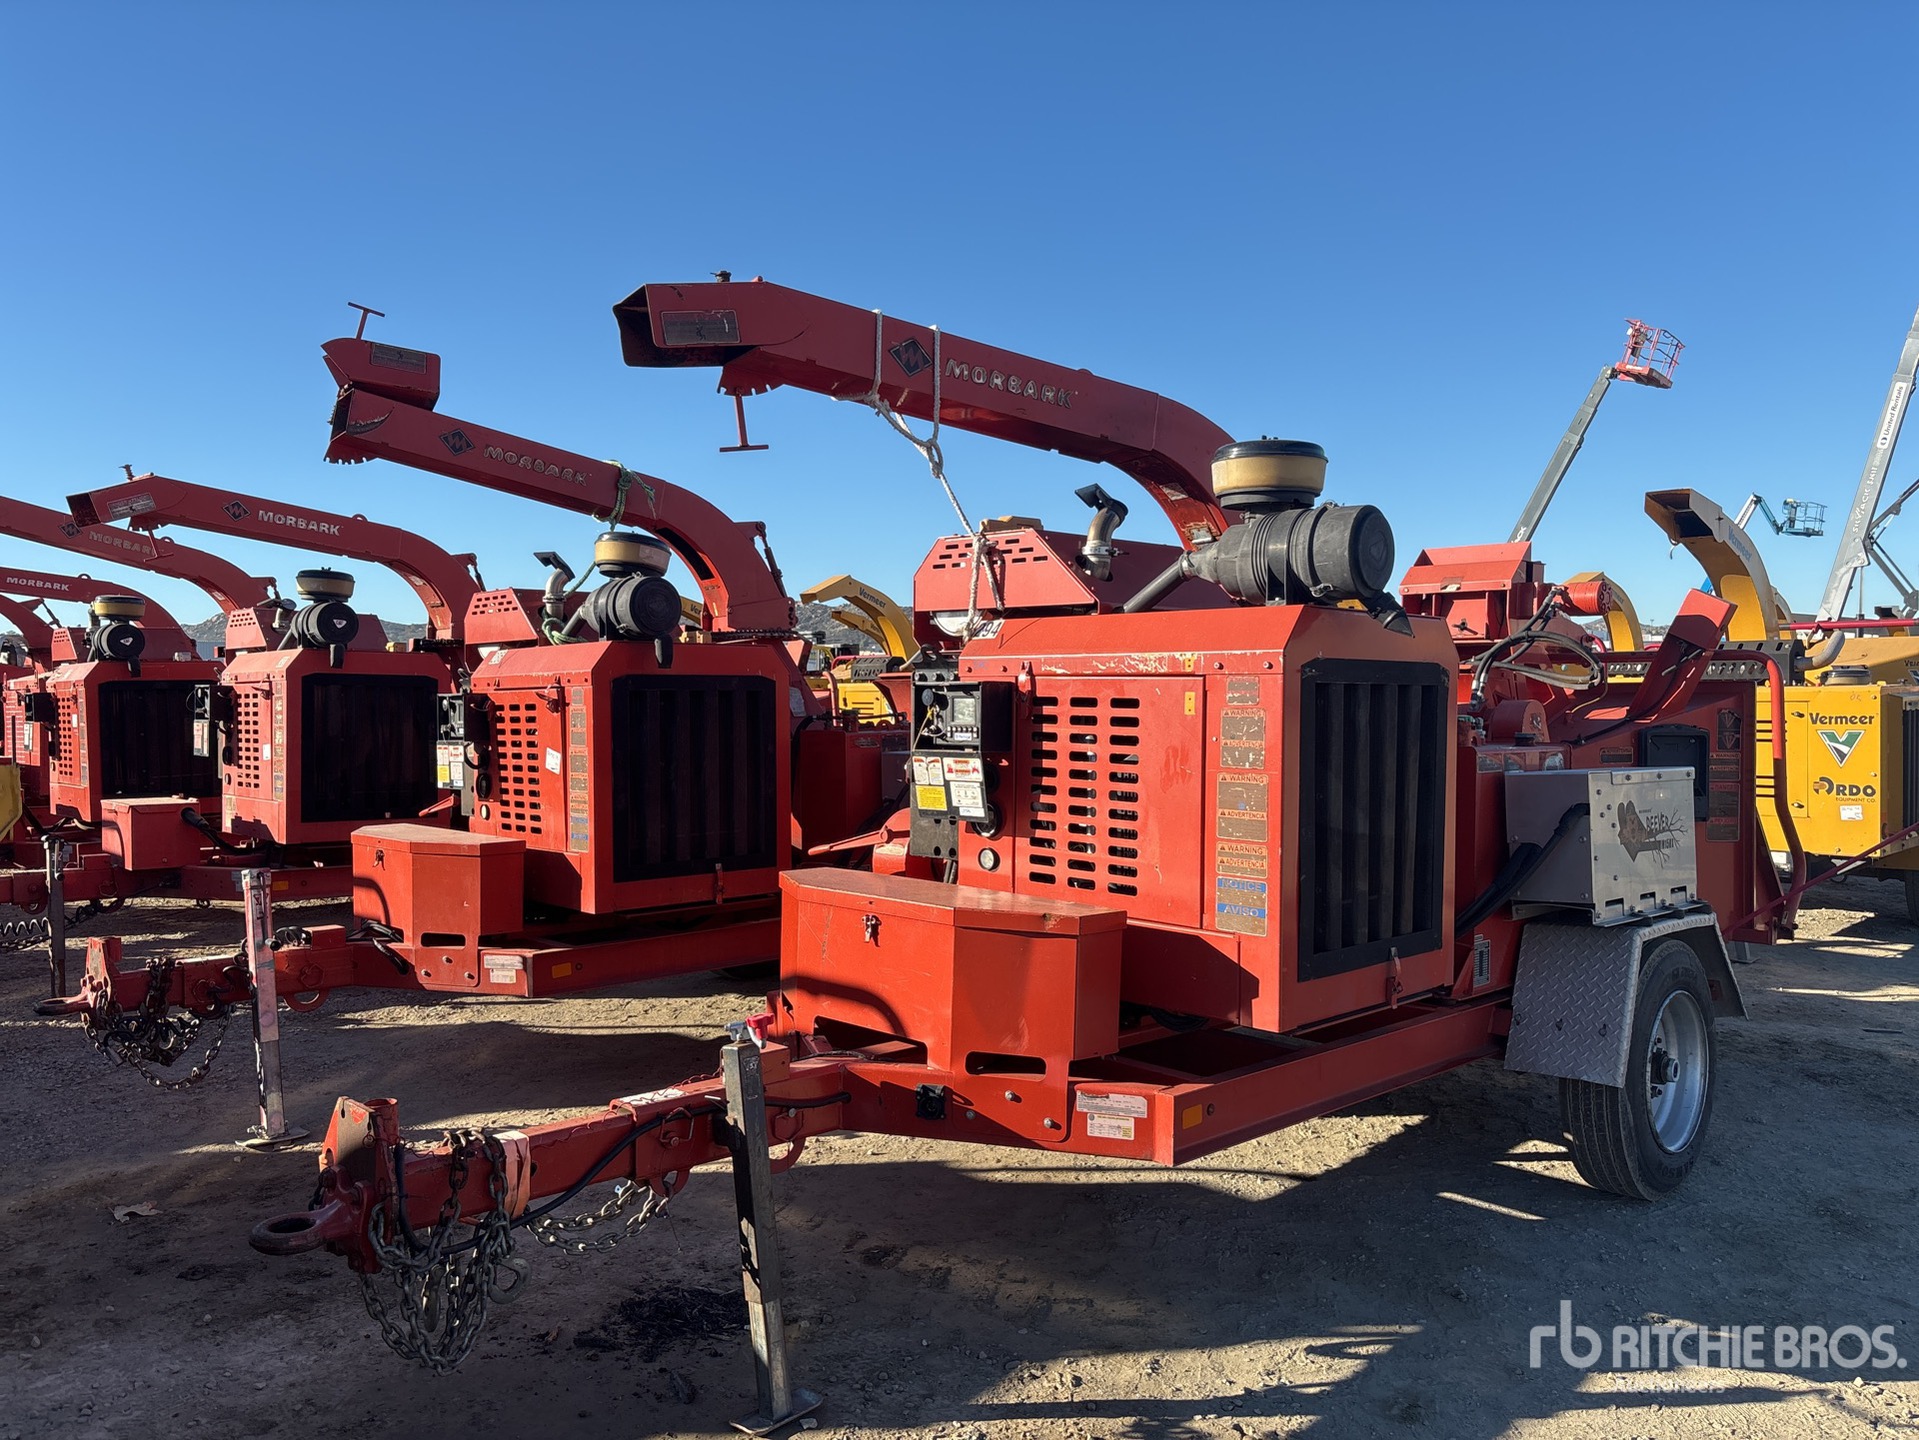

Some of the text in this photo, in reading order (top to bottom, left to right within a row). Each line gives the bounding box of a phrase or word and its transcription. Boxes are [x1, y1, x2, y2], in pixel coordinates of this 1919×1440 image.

[944, 358, 1073, 408] MORBARK
[483, 445, 588, 487] MORBARK
[257, 509, 341, 536] MORBARK
[1728, 525, 1753, 562] Vermeer
[6, 576, 70, 591] MORBARK
[858, 587, 887, 609] Vermeer
[1809, 712, 1875, 725] Vermeer
[1230, 775, 1264, 783] WARNING
[1836, 784, 1876, 797] RDO
[1227, 811, 1265, 819] ADVERTENCIA
[1227, 846, 1263, 855] WARNING
[1226, 858, 1265, 868] ADVERTENCIA
[1221, 879, 1262, 891] NOTICE
[1224, 904, 1259, 917] AVISO
